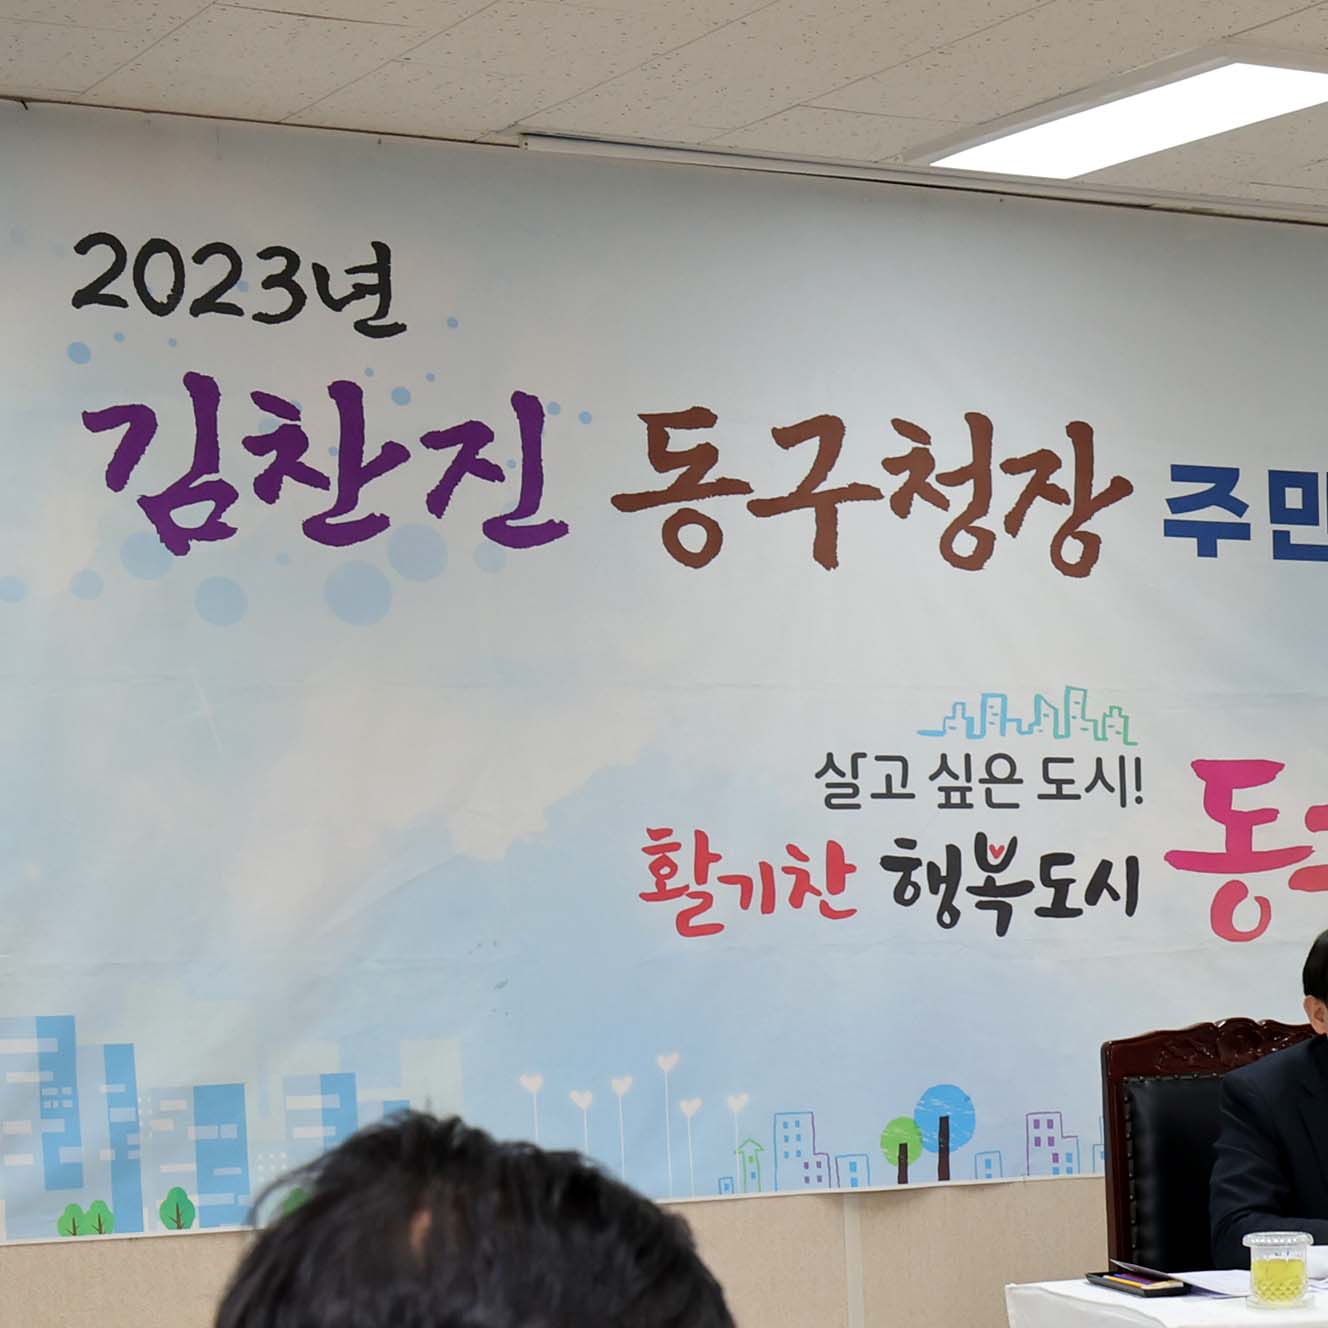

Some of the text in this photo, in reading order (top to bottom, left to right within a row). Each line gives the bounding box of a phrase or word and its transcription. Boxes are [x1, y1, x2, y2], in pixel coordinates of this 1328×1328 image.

[71, 232, 407, 339] 2023년
[82, 371, 570, 556] 김찬진
[610, 405, 1134, 578] 동구청장
[814, 750, 1144, 811] 살고 싶은 도시!
[638, 826, 857, 938] 활기찬
[879, 831, 1140, 938] 행복도시
